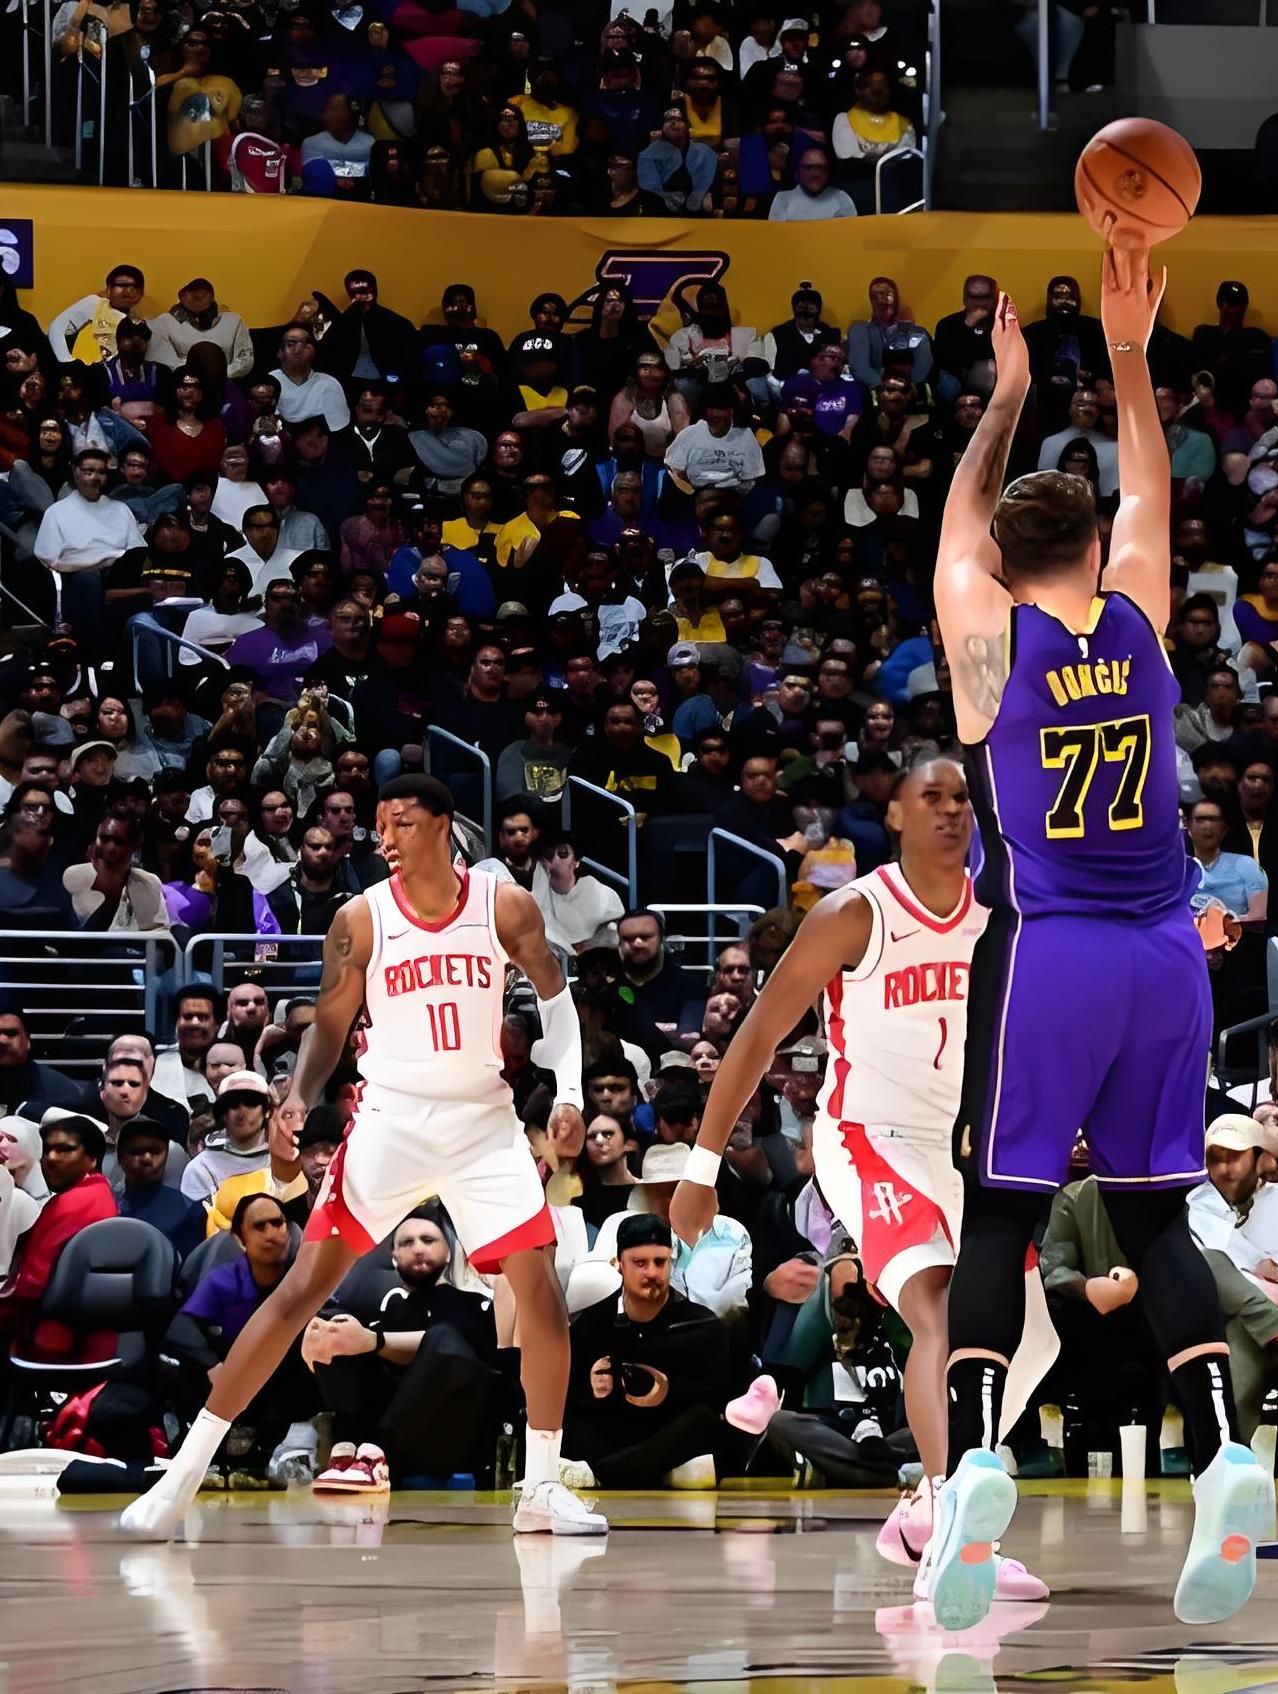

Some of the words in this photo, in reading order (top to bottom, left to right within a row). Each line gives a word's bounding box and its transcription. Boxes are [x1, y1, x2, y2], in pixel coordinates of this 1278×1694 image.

[1039, 714, 1151, 839] 77
[384, 954, 492, 997] ROCKETS
[884, 962, 971, 1010] ROCKE
[426, 1002, 461, 1052] 10
